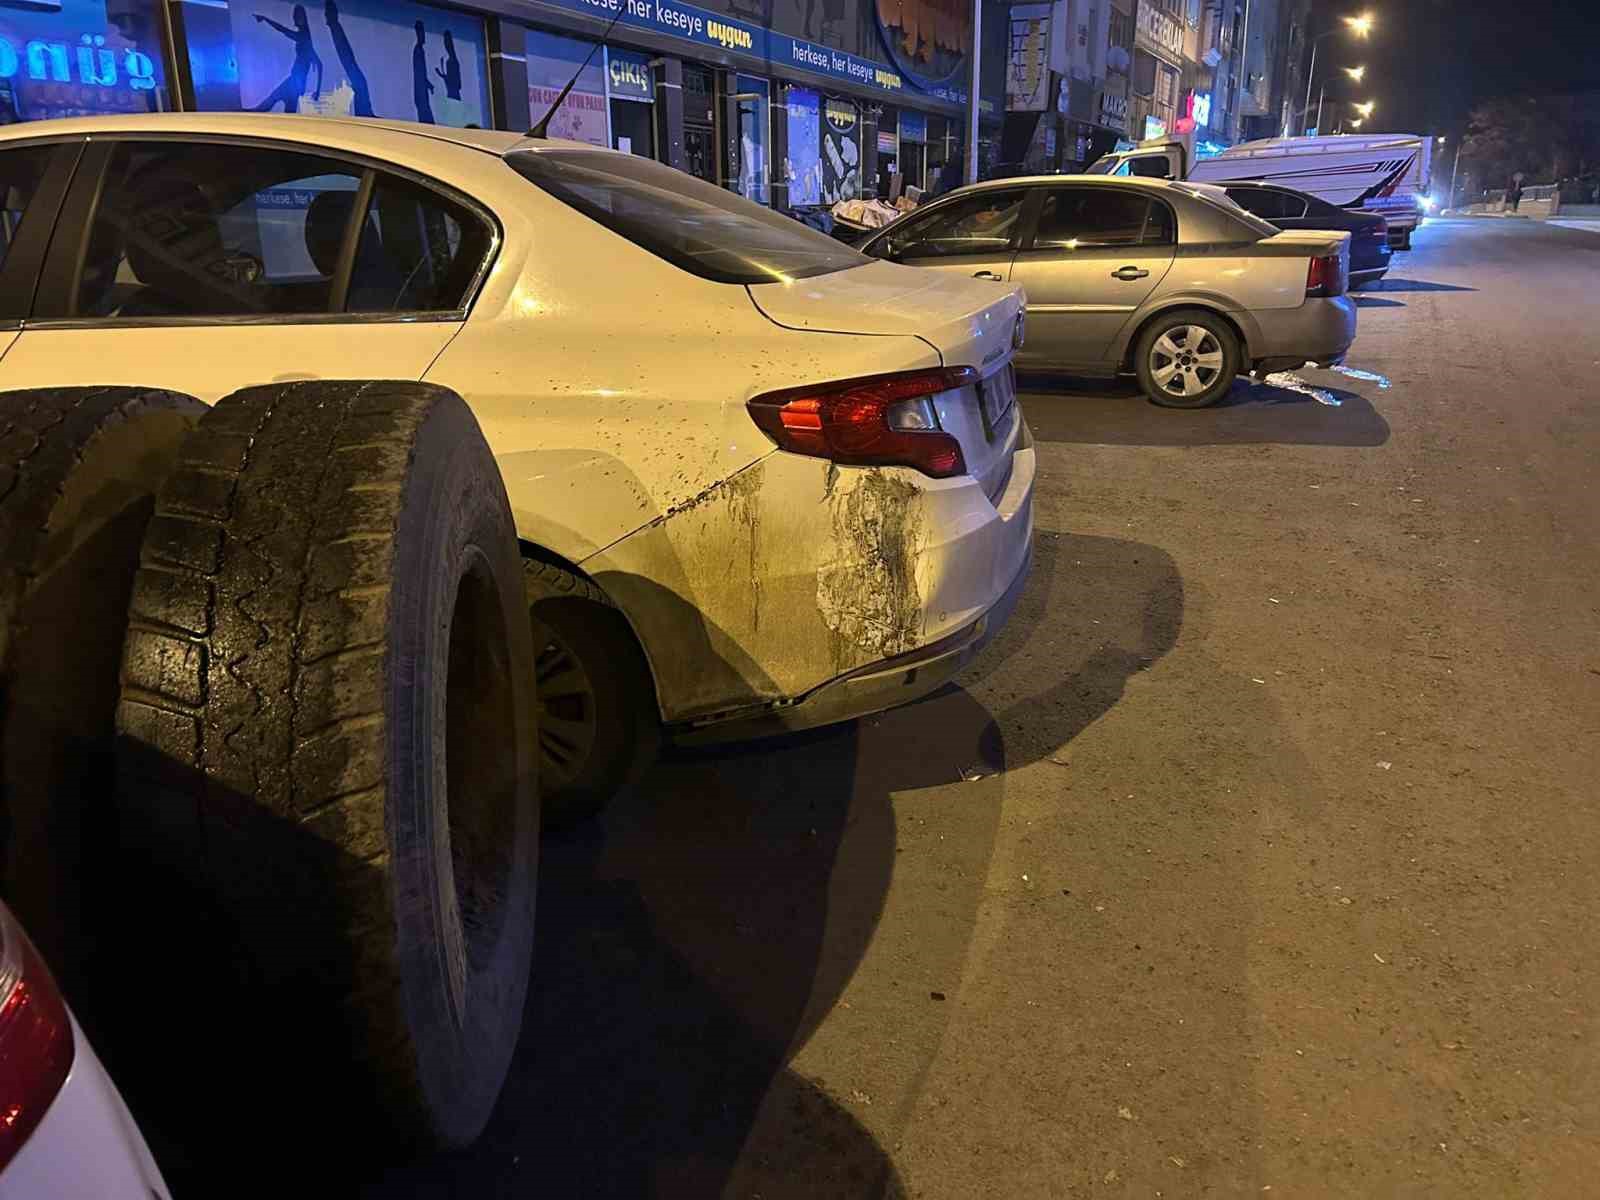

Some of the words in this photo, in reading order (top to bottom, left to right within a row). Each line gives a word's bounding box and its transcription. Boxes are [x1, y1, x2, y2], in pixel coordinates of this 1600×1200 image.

[627, 0, 652, 19] her
[655, 0, 703, 36] keseye
[706, 20, 753, 49] uygun
[610, 59, 649, 92] ÇIKIŞ
[792, 40, 830, 71] herkese,
[832, 52, 846, 73] her
[847, 56, 874, 83] keseye
